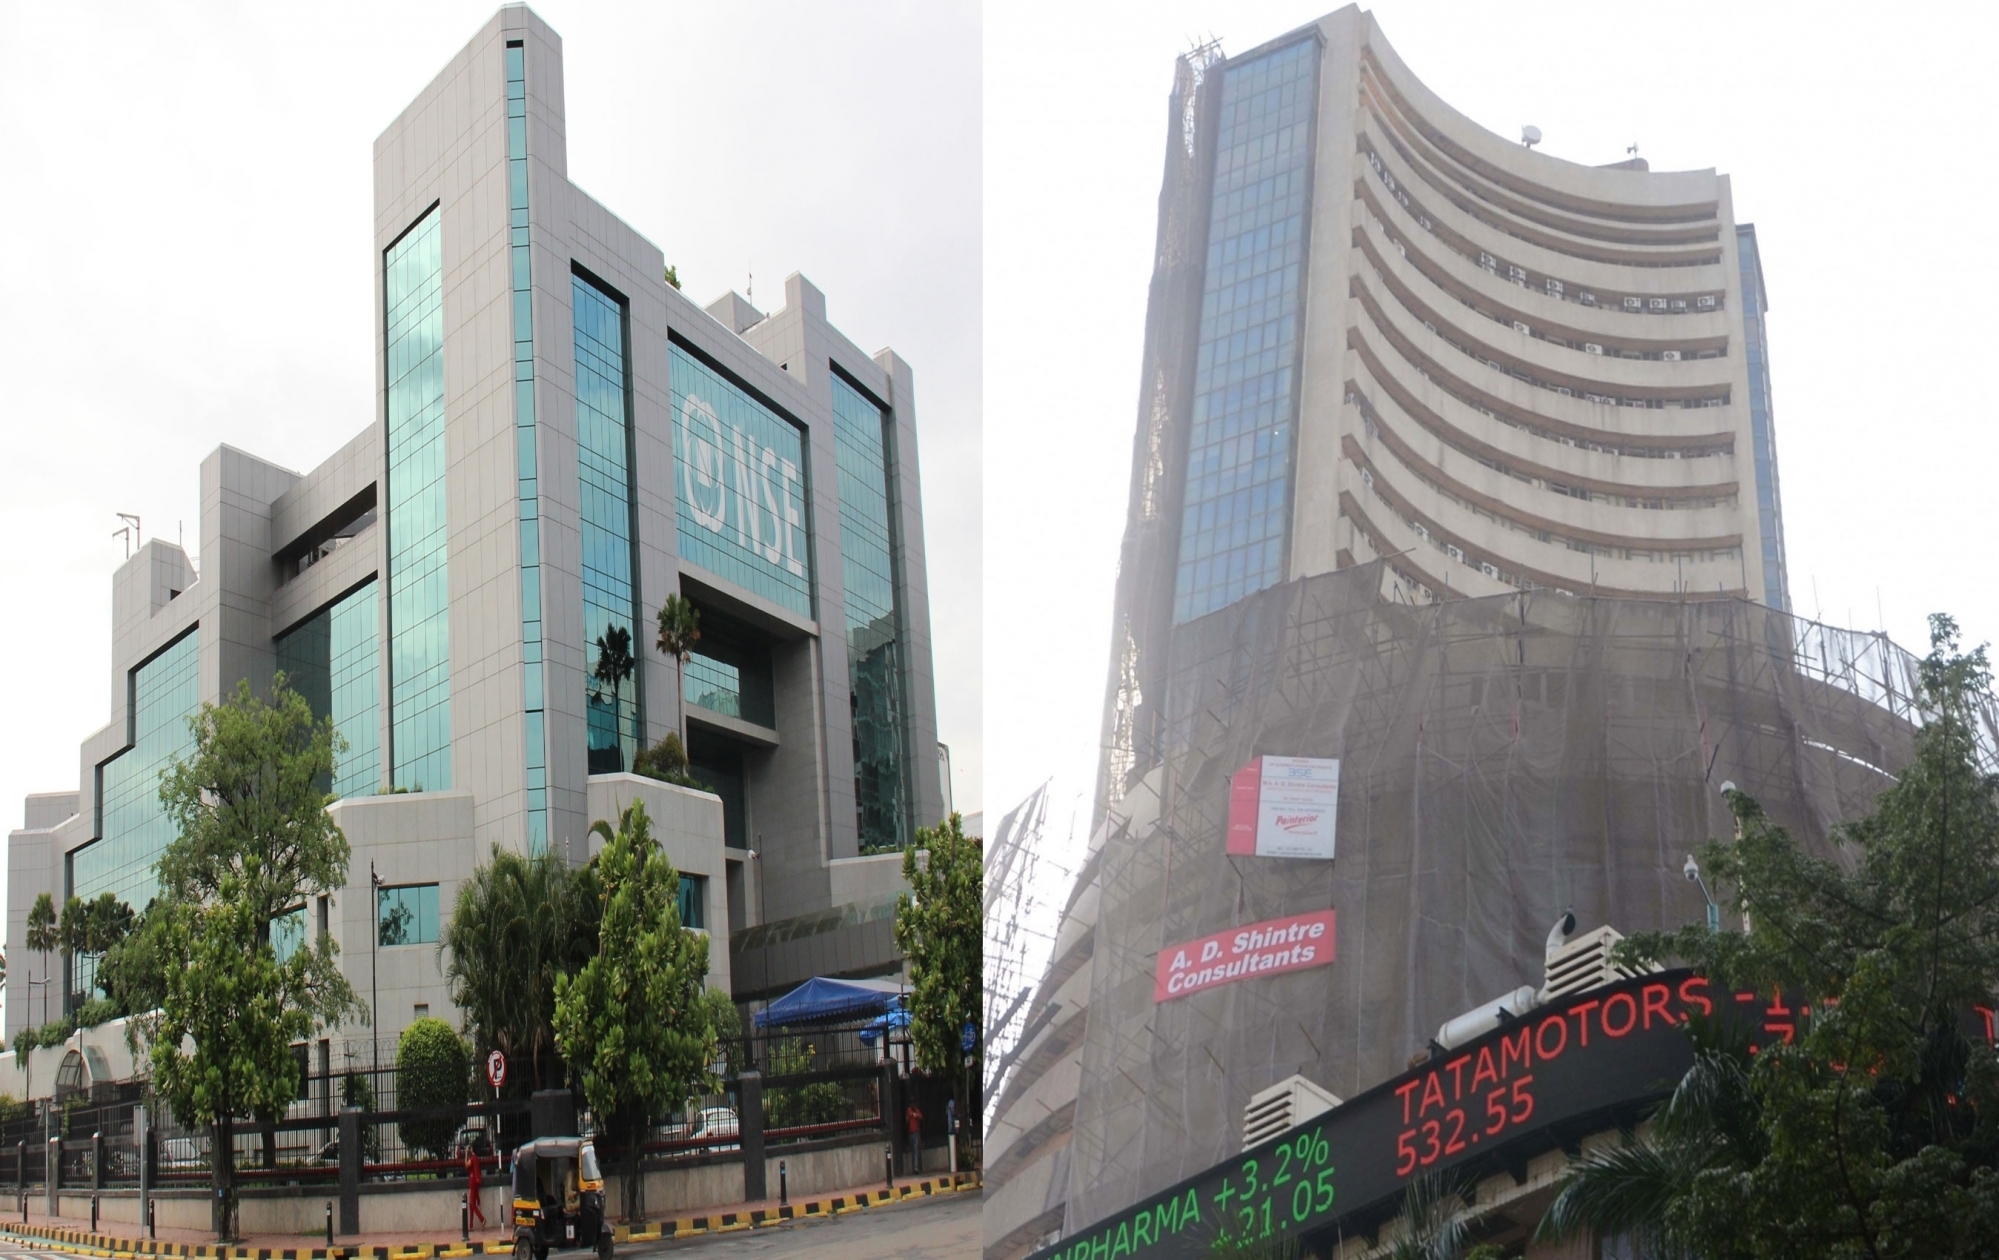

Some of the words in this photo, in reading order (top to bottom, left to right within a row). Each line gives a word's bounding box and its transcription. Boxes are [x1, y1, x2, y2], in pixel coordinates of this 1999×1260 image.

[733, 424, 803, 577] NSE
[1167, 945, 1315, 993] Consultants
[1169, 950, 1192, 973] A.
[1200, 941, 1224, 963] D.
[1232, 922, 1325, 953] Shintre
[1395, 977, 1713, 1125] TATAMOTORS
[1213, 1126, 1329, 1212] +3.2%
[1396, 1075, 1534, 1177] 532.55
